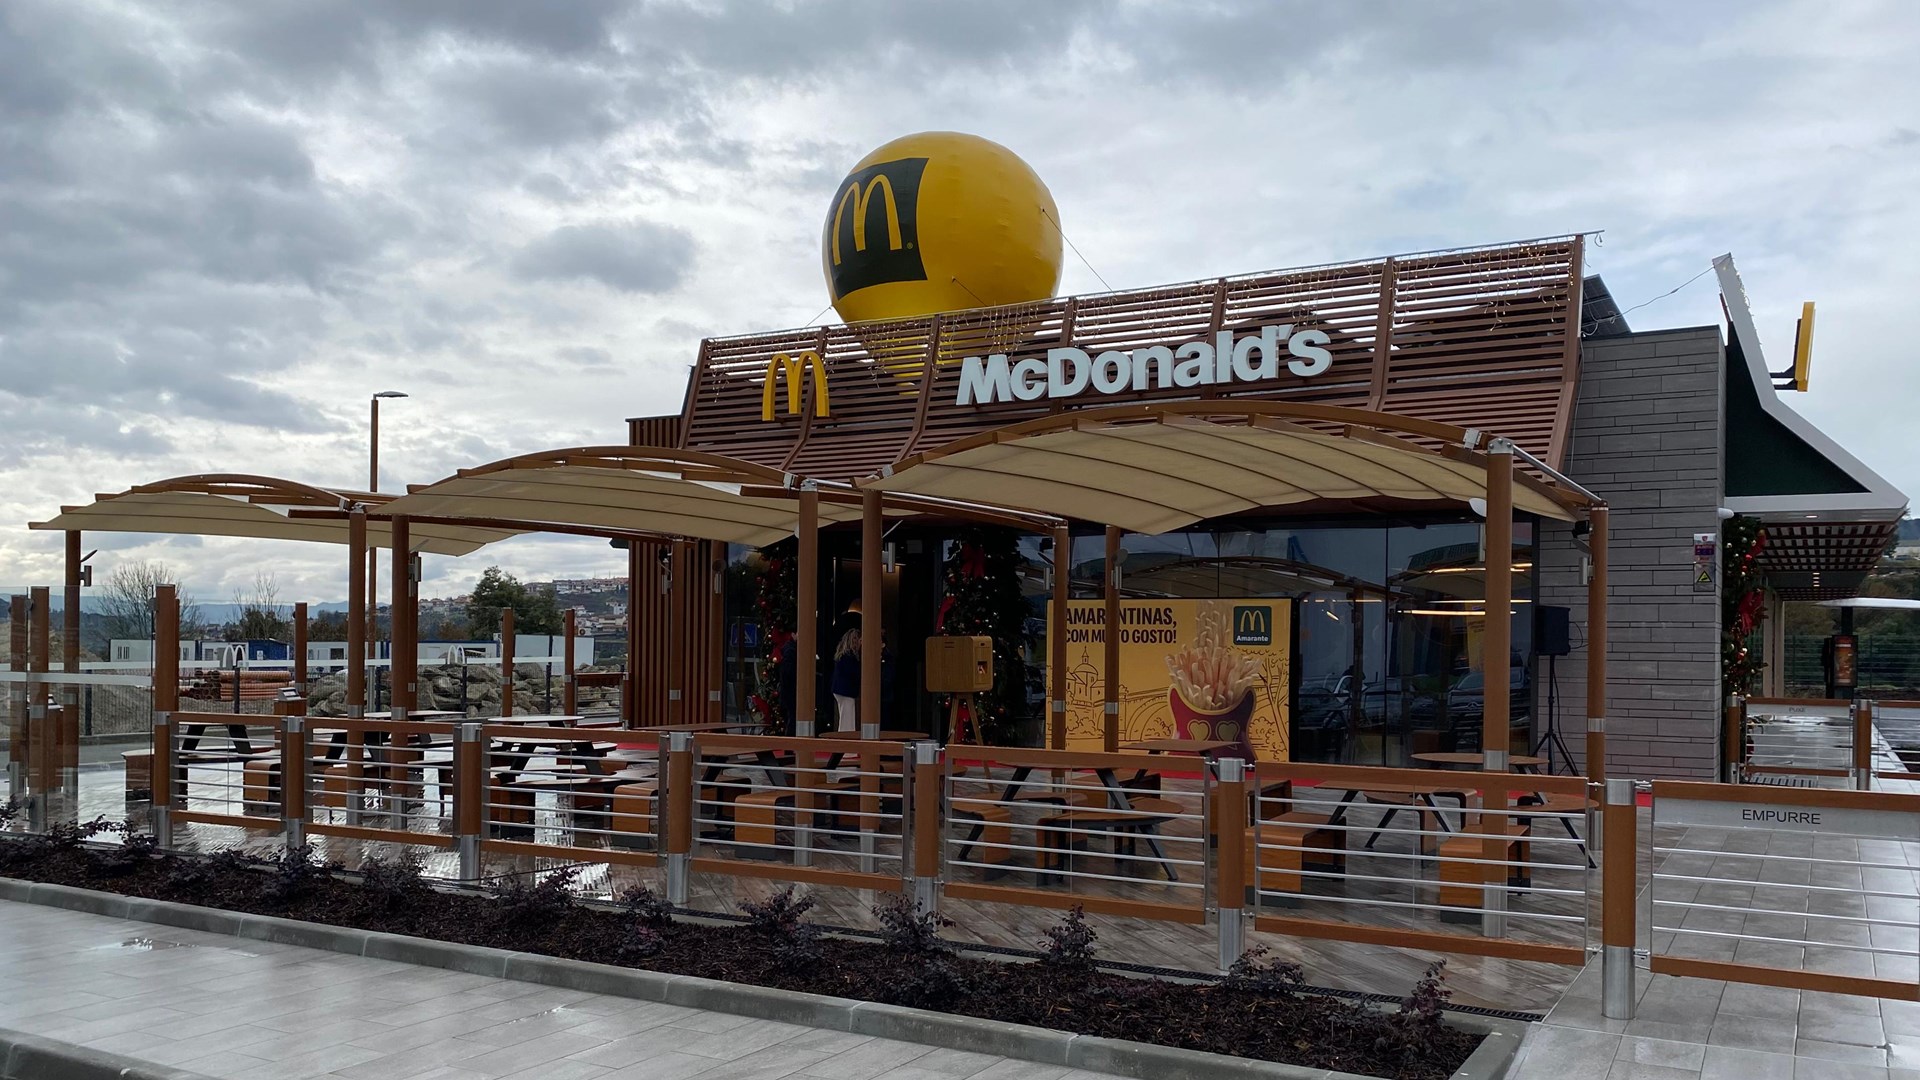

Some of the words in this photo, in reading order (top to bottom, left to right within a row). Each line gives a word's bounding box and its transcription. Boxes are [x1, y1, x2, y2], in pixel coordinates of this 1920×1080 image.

[955, 325, 1333, 406] McDonald's
[1066, 607, 1177, 628] AMARNTINAS,
[1132, 629, 1177, 643] GOSTO!
[1742, 809, 1821, 824] EMPURRE
